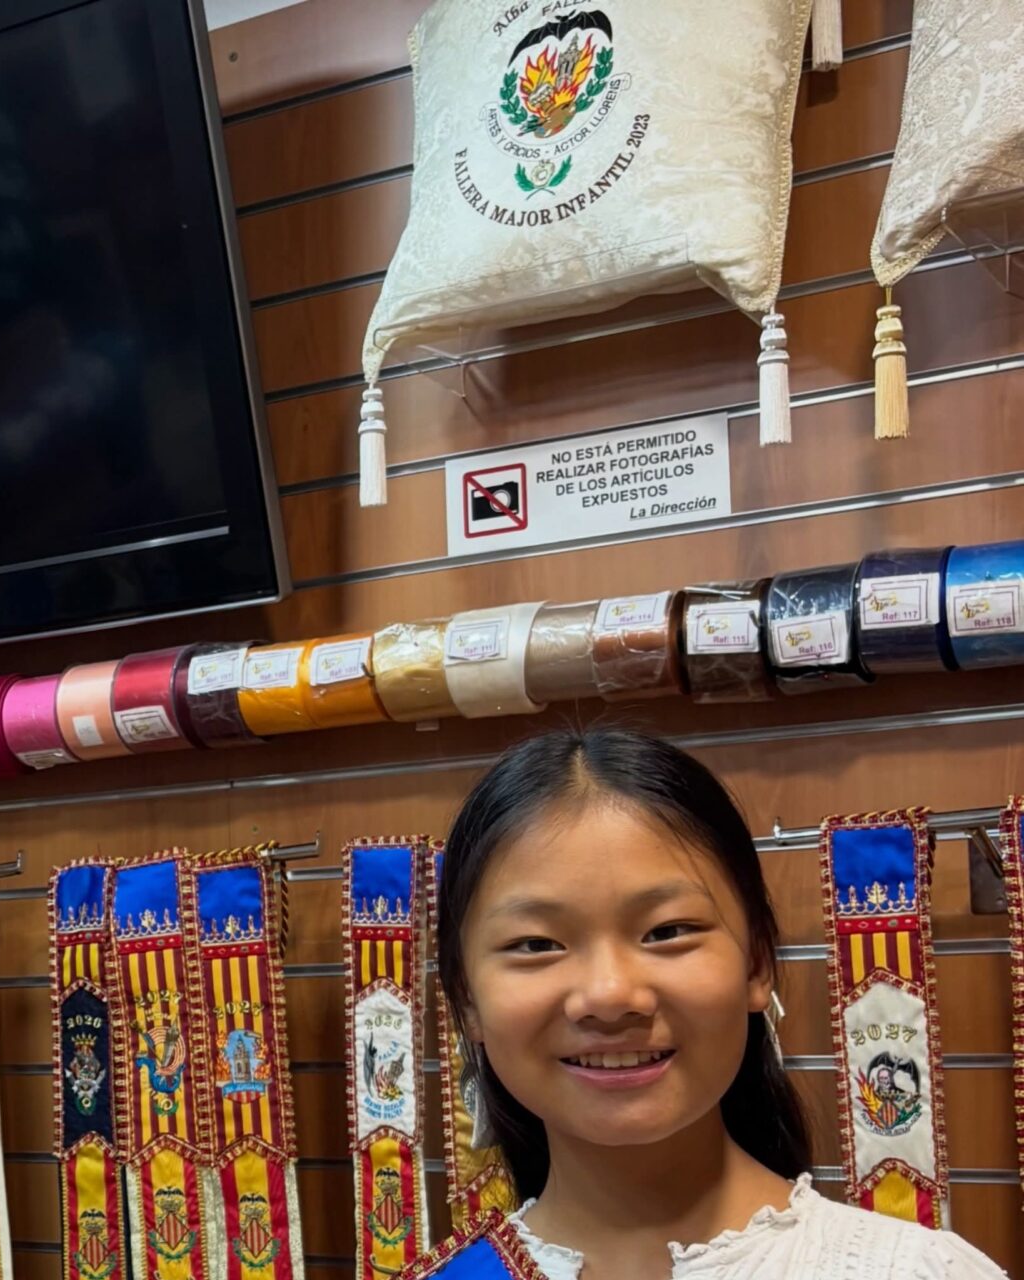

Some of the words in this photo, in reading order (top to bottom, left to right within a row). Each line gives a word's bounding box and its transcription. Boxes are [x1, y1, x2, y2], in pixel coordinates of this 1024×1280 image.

[493, 1, 530, 37] Alba
[489, 107, 502, 137] ARTES
[497, 136, 506, 146] Y
[553, 127, 591, 156] ACTOR
[591, 78, 622, 130] LLORENS
[454, 147, 487, 216] FALLERA
[489, 204, 553, 227] MAJOR
[555, 152, 636, 221] INFANTIL
[626, 112, 651, 149] 2023
[536, 461, 606, 484] REALIZAR
[610, 443, 715, 472] FOTOGRAFÍAS
[551, 451, 572, 465] NO
[576, 441, 613, 461] ESTÁ
[617, 429, 697, 453] PERMITIDO
[555, 482, 574, 496] DE
[578, 477, 608, 493] LOS
[611, 463, 695, 488] ARTÍCULOS
[582, 484, 669, 508] EXPUESTOS
[629, 505, 646, 521] La
[650, 495, 718, 518] Dirección
[213, 1000, 265, 1020] 2027
[850, 1023, 919, 1047] 2027
